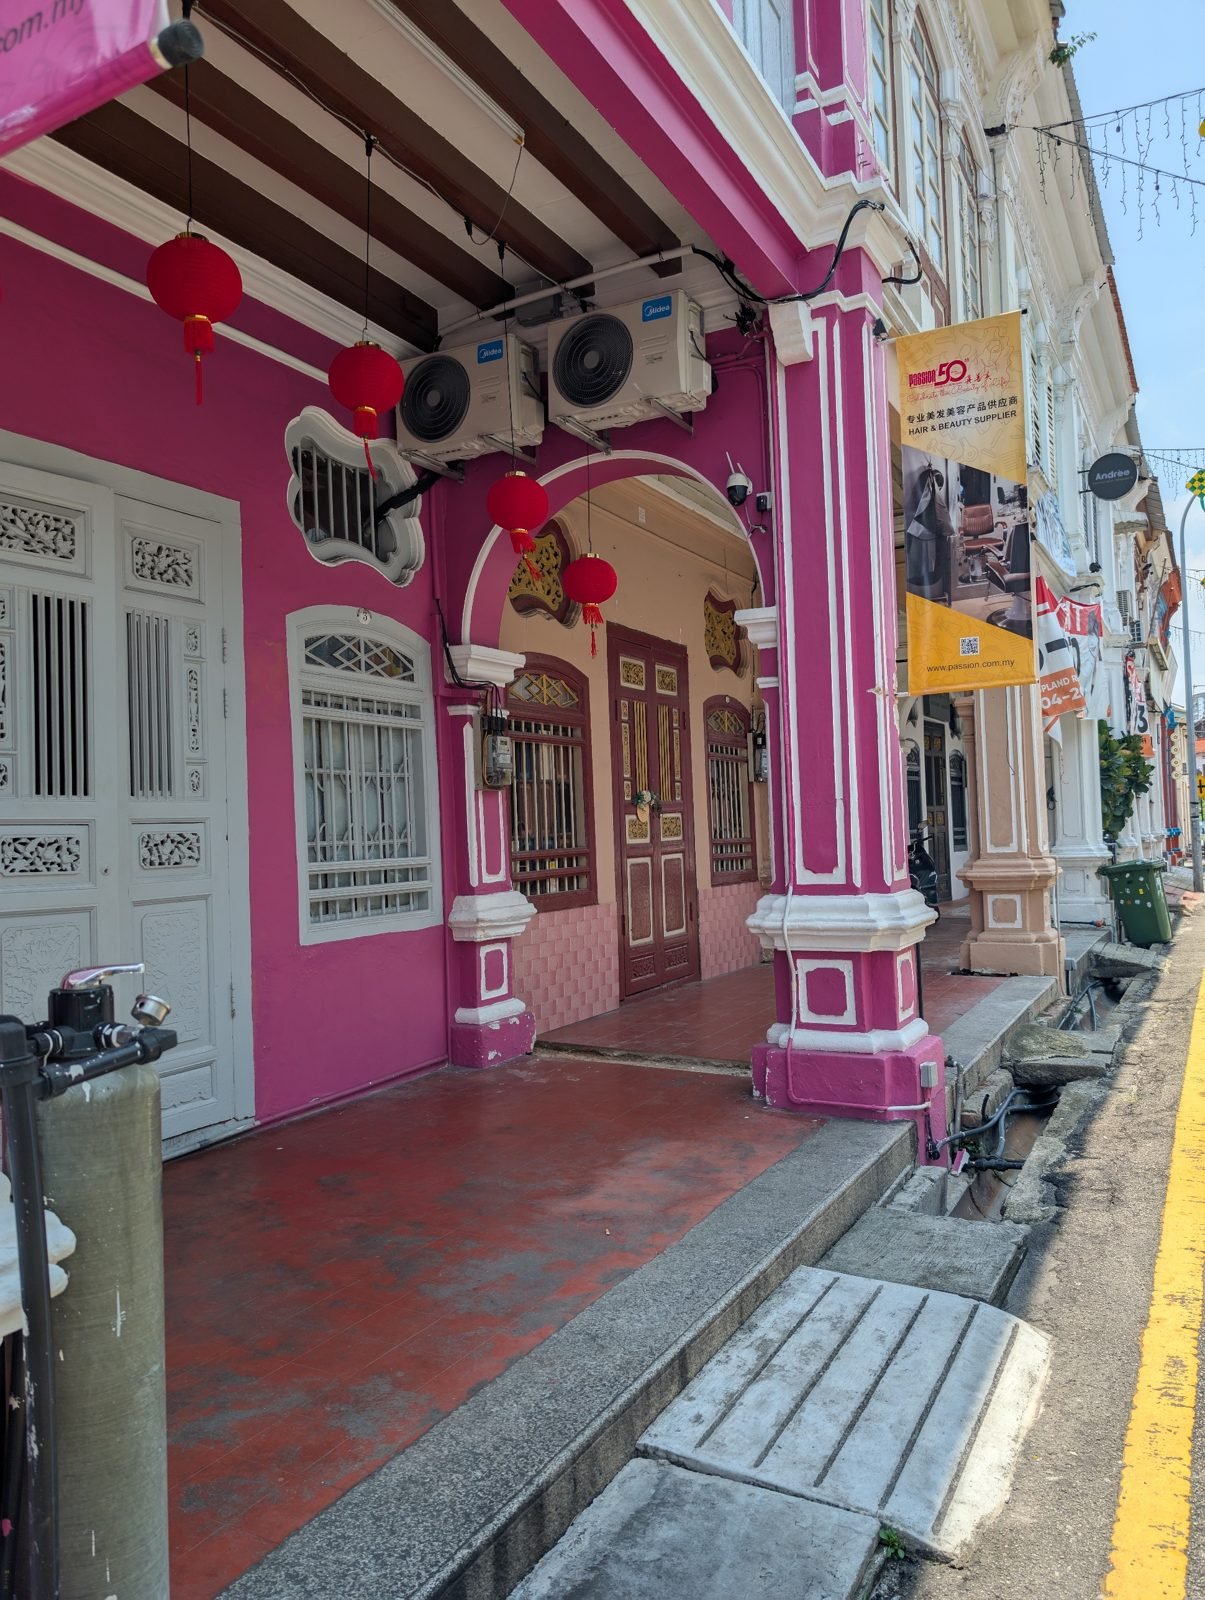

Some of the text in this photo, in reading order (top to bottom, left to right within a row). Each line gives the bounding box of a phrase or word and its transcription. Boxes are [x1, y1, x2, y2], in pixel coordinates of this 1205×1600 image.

[644, 305, 670, 317] Midea
[907, 395, 1018, 424] 专业美发美容产品供应商
[908, 409, 1018, 436] HAIR & BEAUTY SUPPLIER
[926, 659, 1015, 673] www.passion.com.my
[1041, 687, 1084, 709] 04-2
